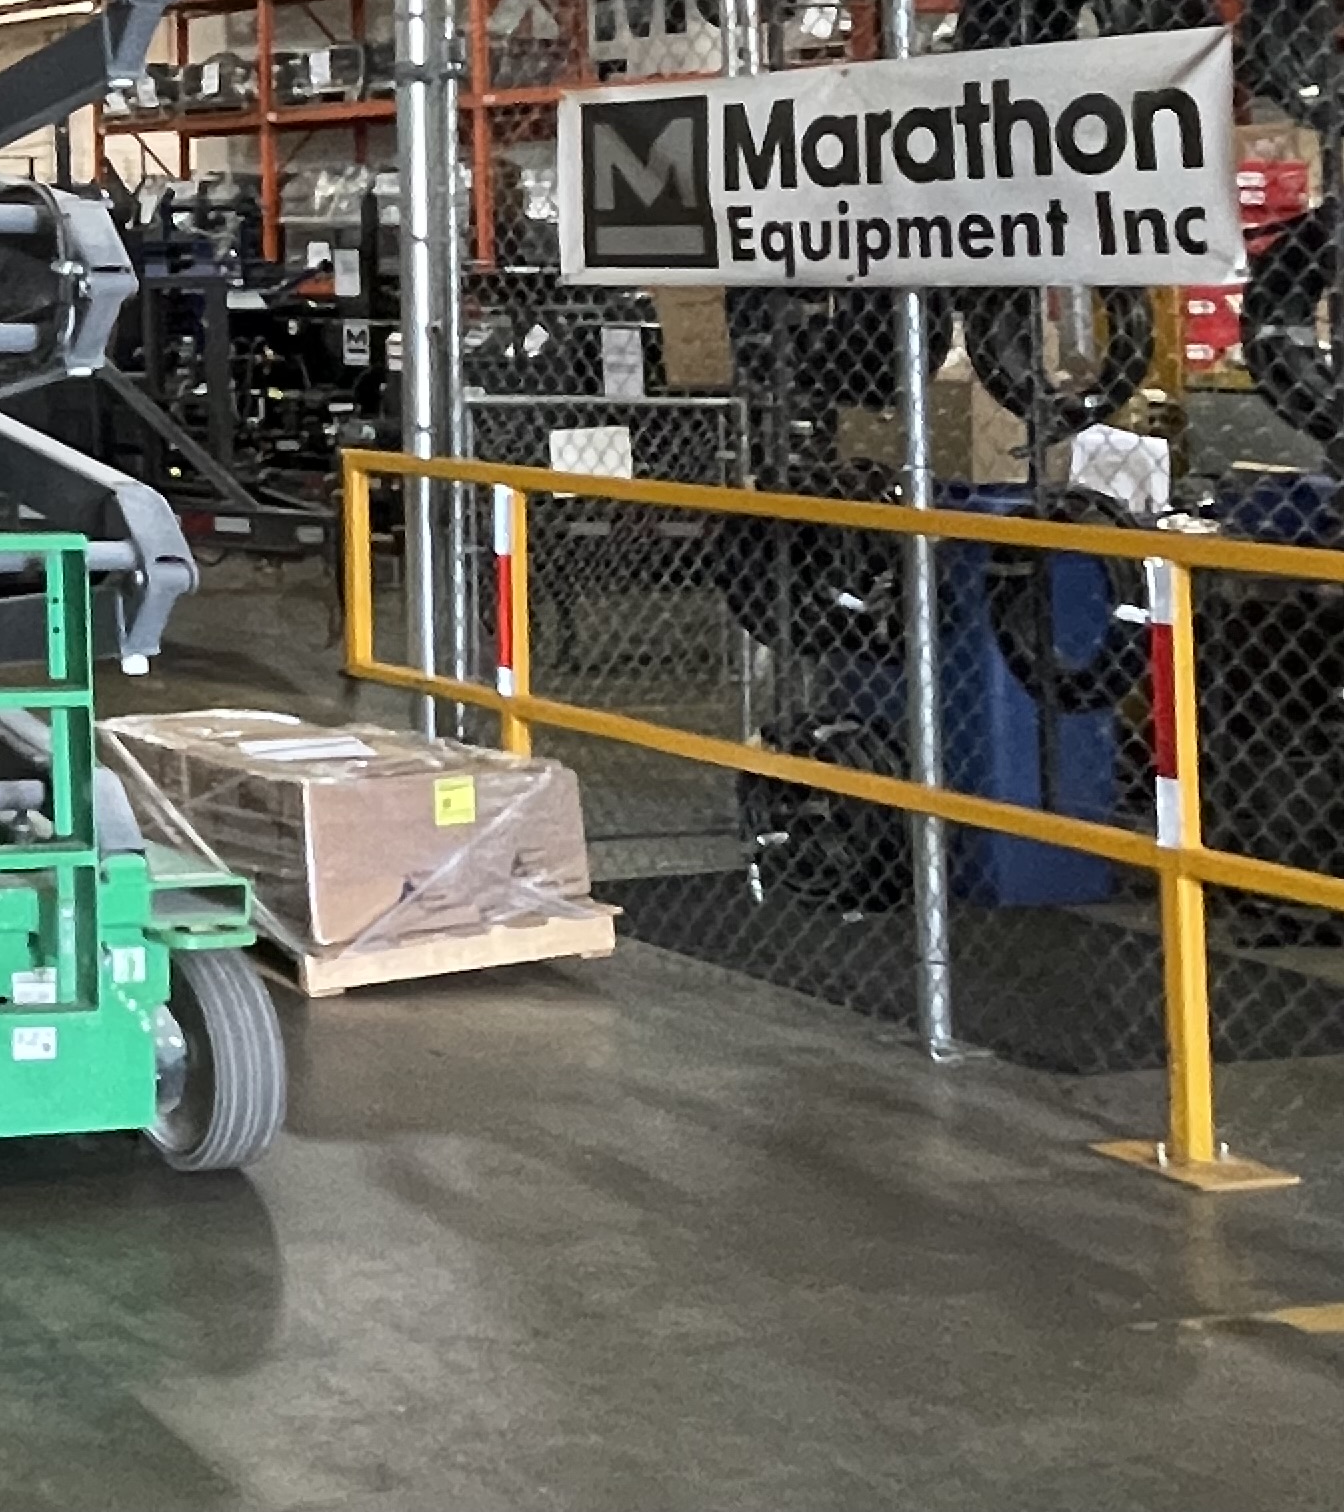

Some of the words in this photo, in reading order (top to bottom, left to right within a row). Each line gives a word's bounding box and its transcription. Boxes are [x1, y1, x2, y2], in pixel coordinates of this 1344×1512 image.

[593, 116, 698, 212] M
[722, 79, 1205, 192] Marathon
[725, 198, 1069, 278] Equipment
[1093, 190, 1209, 257] Inc
